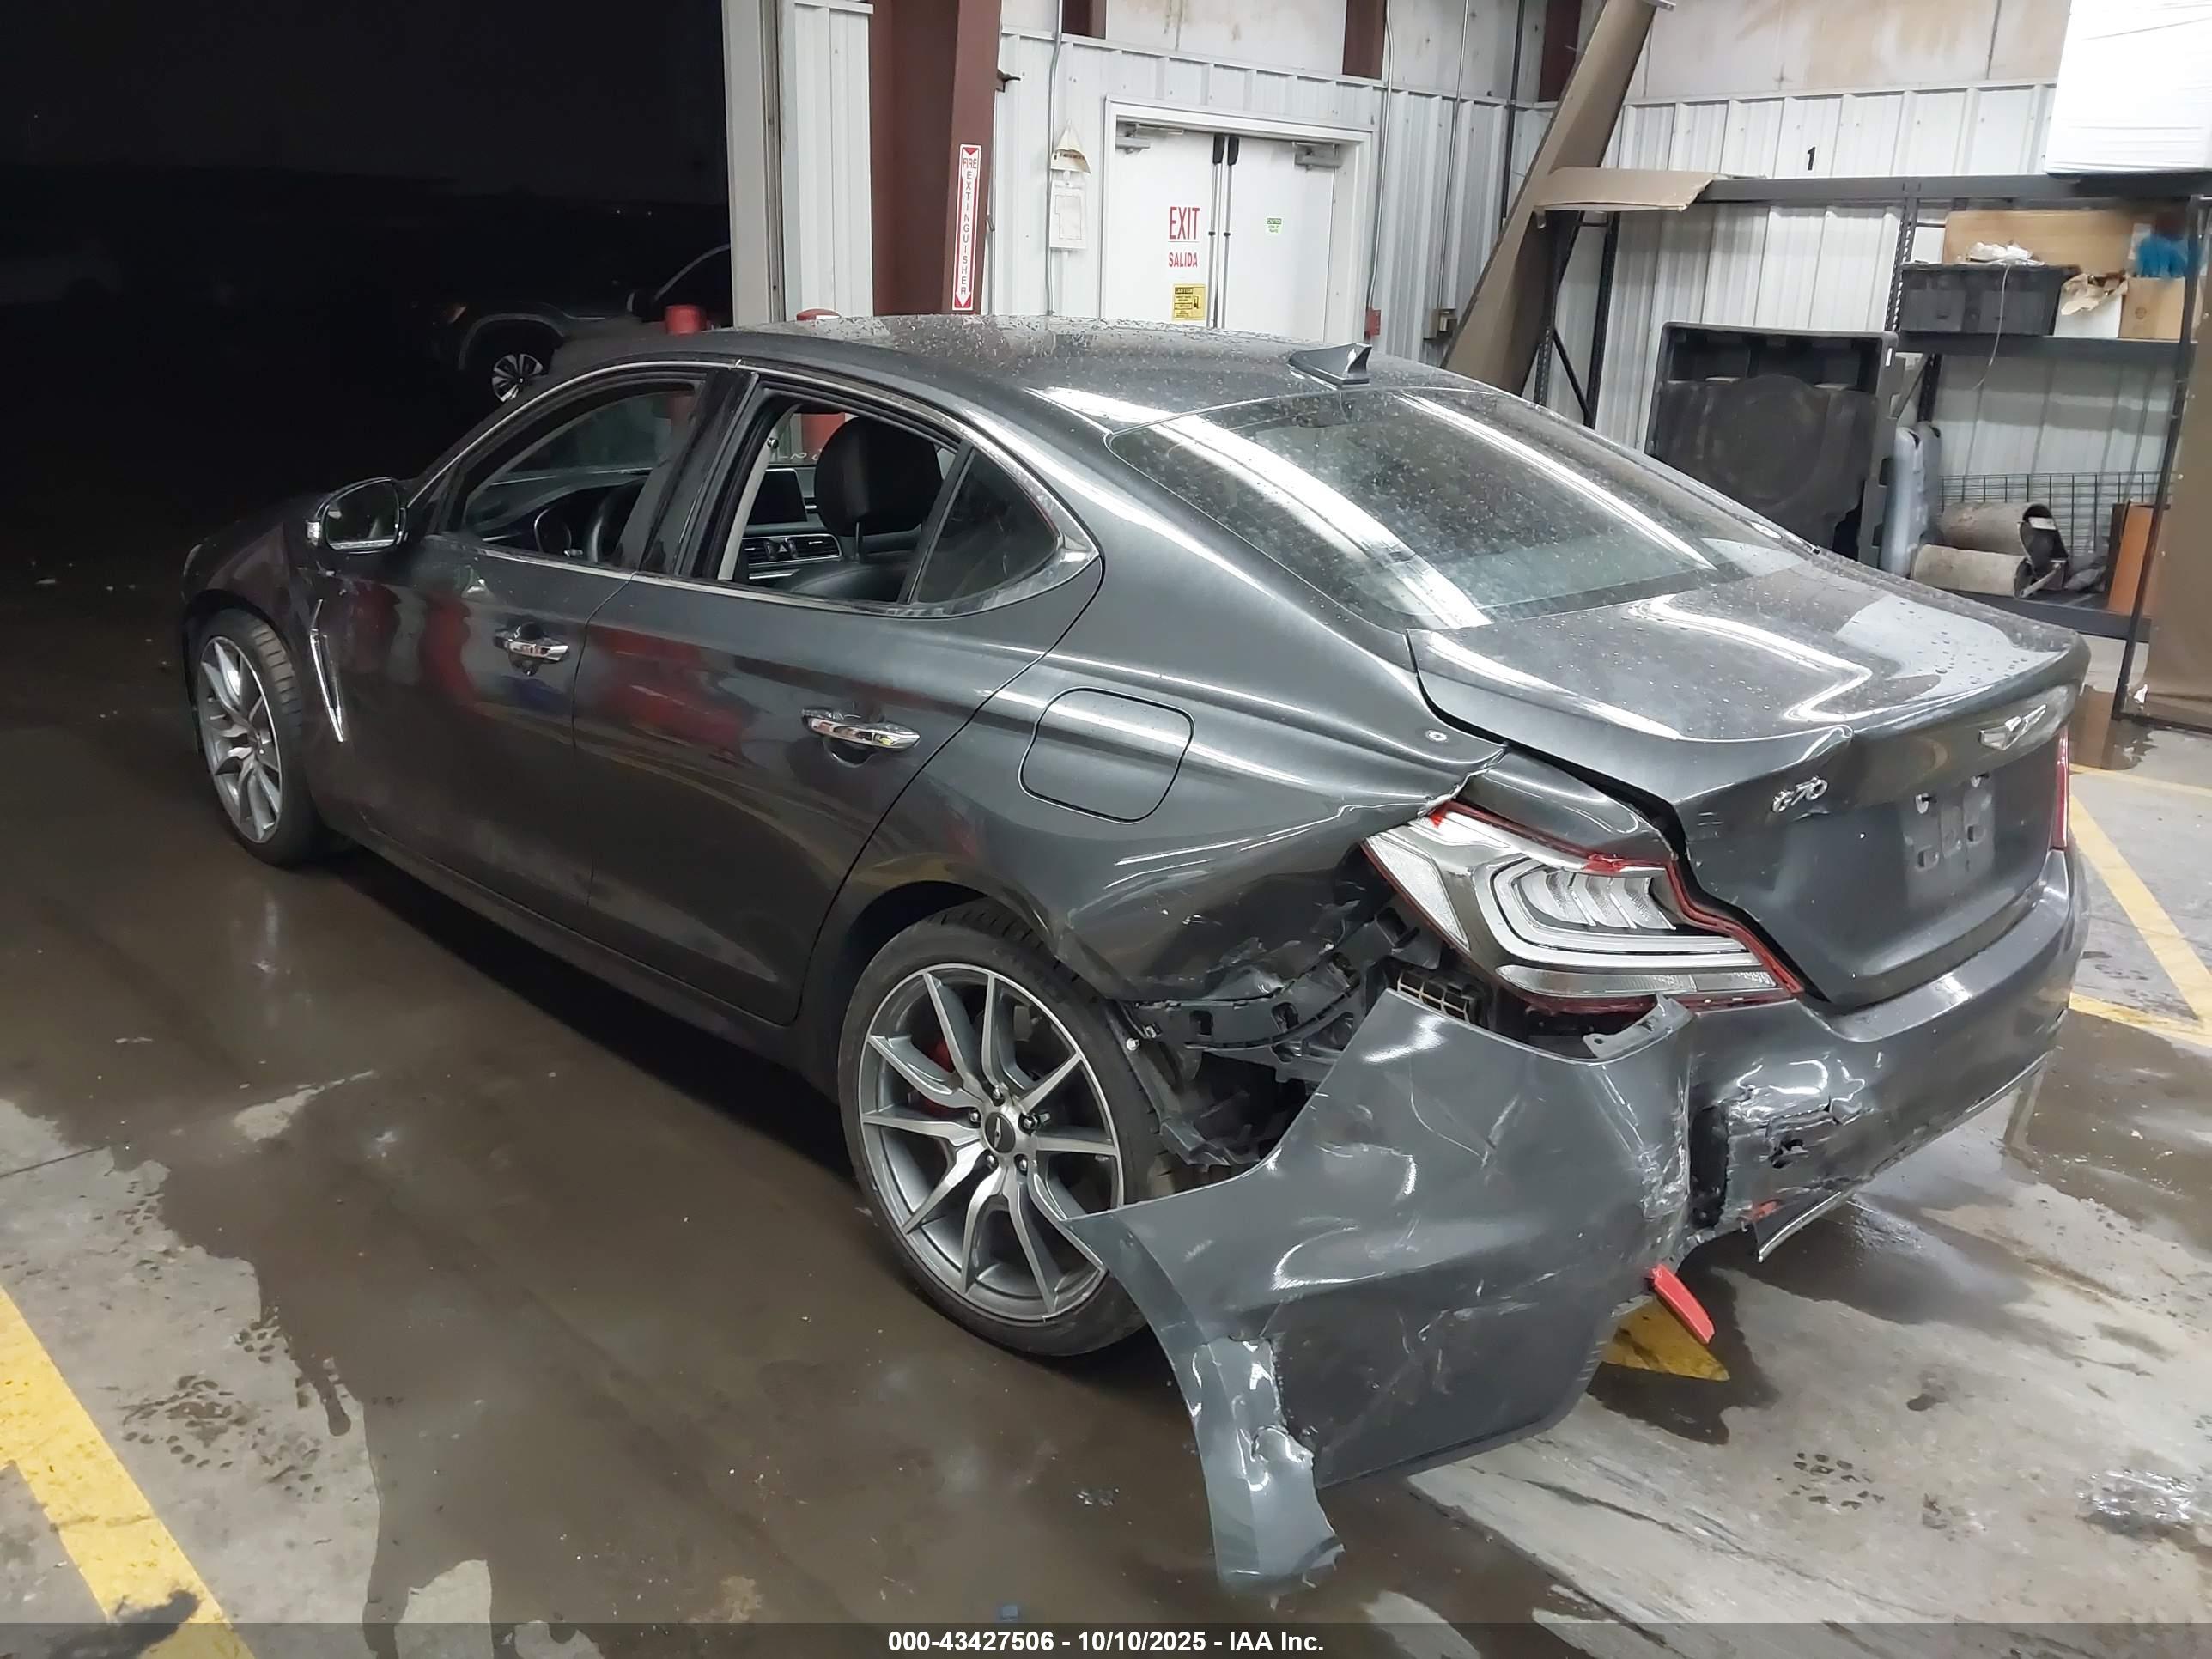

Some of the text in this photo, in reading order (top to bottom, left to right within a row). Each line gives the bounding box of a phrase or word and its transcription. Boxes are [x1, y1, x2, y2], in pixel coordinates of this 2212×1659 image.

[962, 157, 977, 169] FIRE
[1807, 146, 1816, 171] 1
[961, 170, 973, 295] EXTINGUISHER
[1169, 206, 1200, 240] EXIT
[1168, 252, 1198, 268] SALIDA
[1772, 775, 1828, 813] G70
